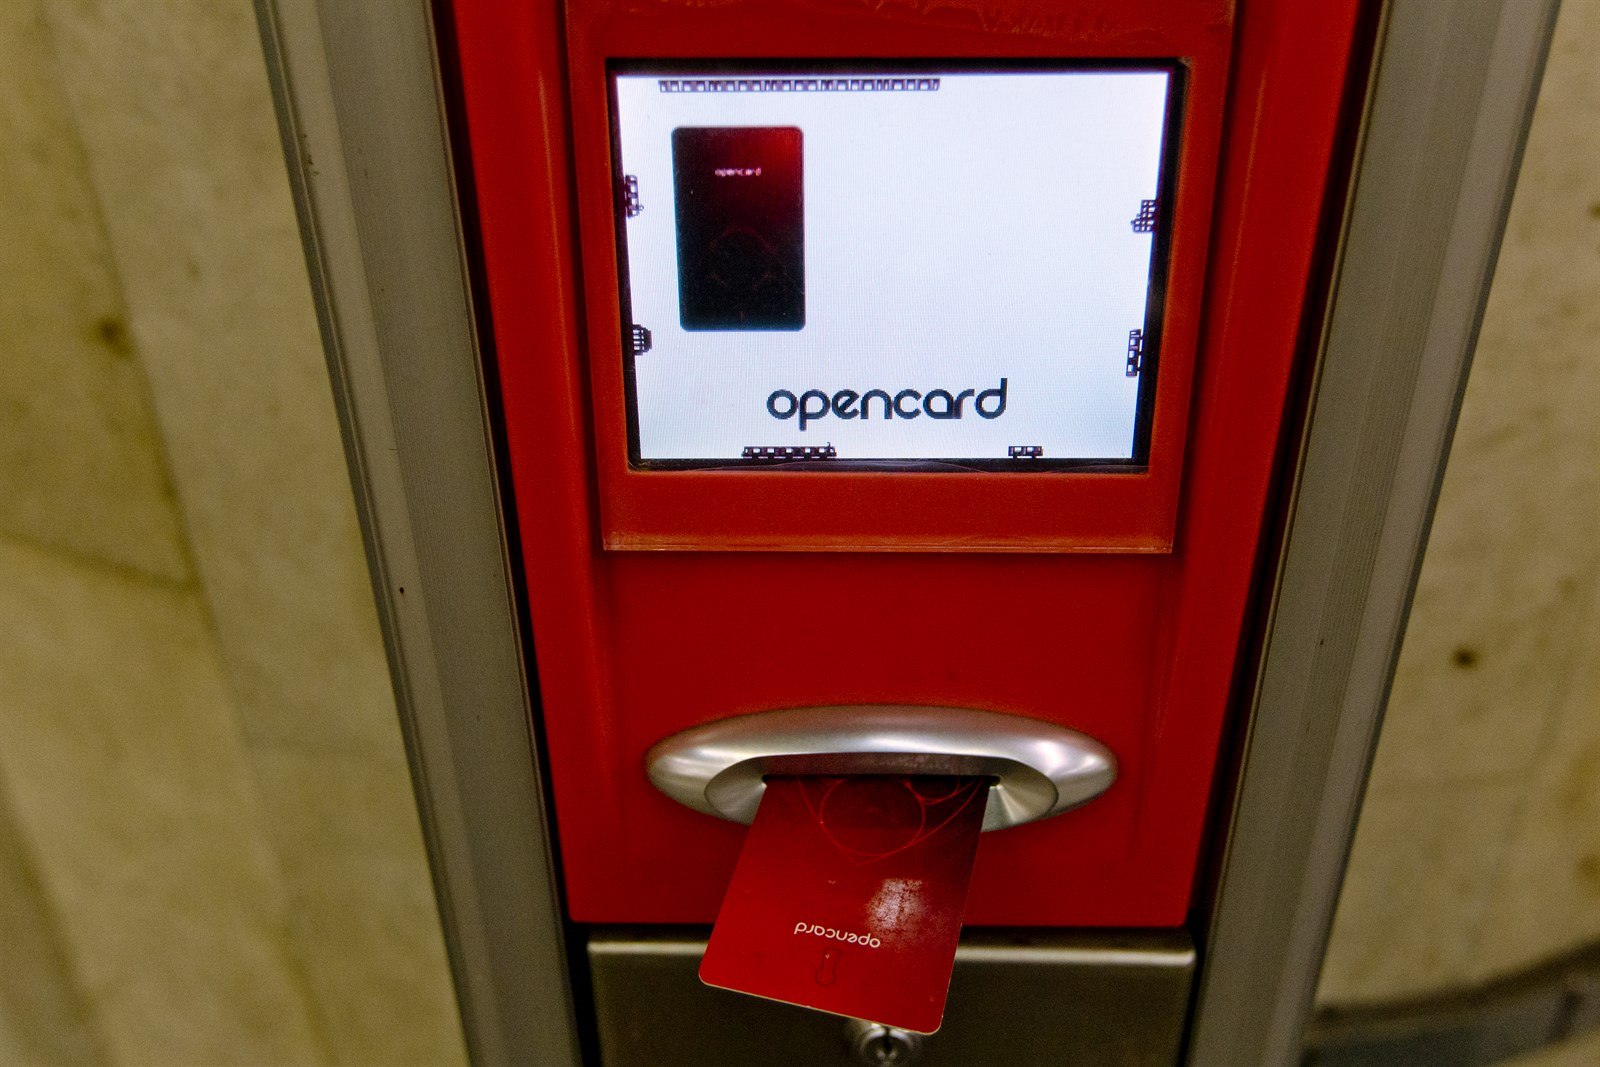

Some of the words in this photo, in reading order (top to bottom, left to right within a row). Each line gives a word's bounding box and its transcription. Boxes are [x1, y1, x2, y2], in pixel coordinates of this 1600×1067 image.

[714, 167, 762, 177] opencard
[767, 378, 1008, 430] opencard
[793, 922, 881, 948] opencard
